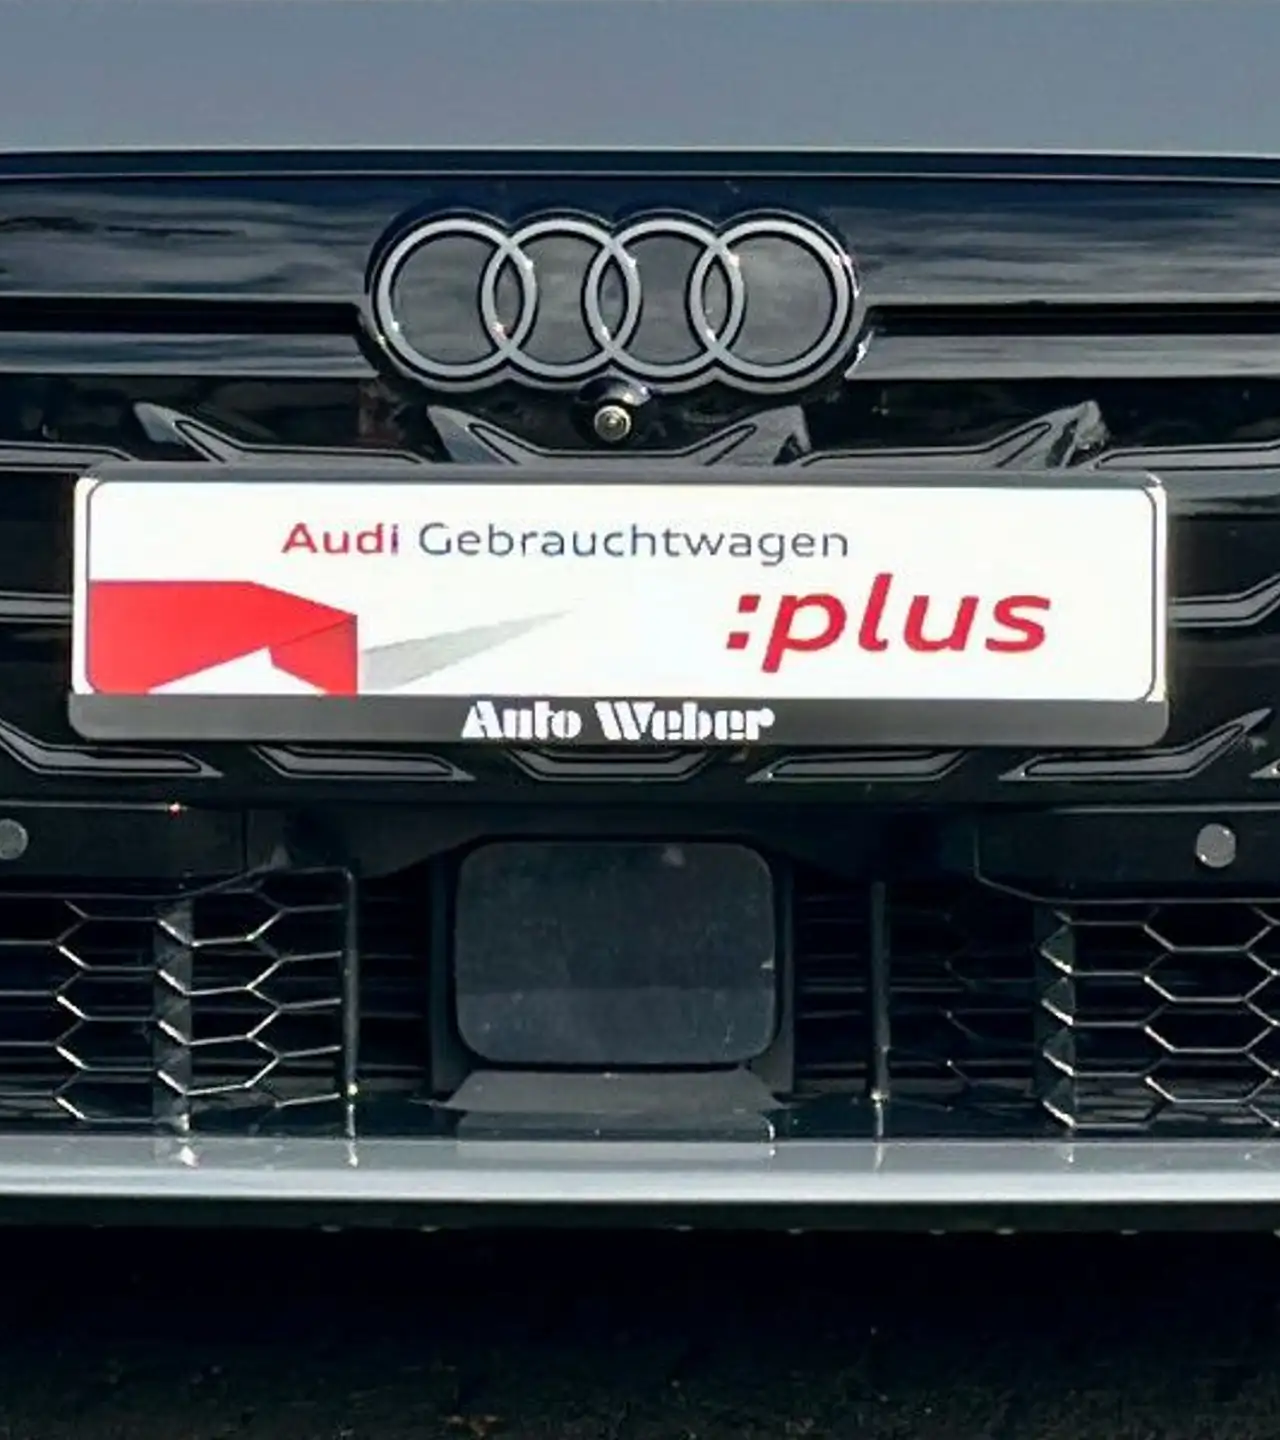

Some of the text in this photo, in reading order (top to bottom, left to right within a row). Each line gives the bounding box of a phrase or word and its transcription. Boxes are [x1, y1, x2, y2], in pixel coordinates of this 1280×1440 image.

[281, 522, 849, 567] Audi Gebrauchtwagen
[460, 700, 776, 741] Auto Weber
